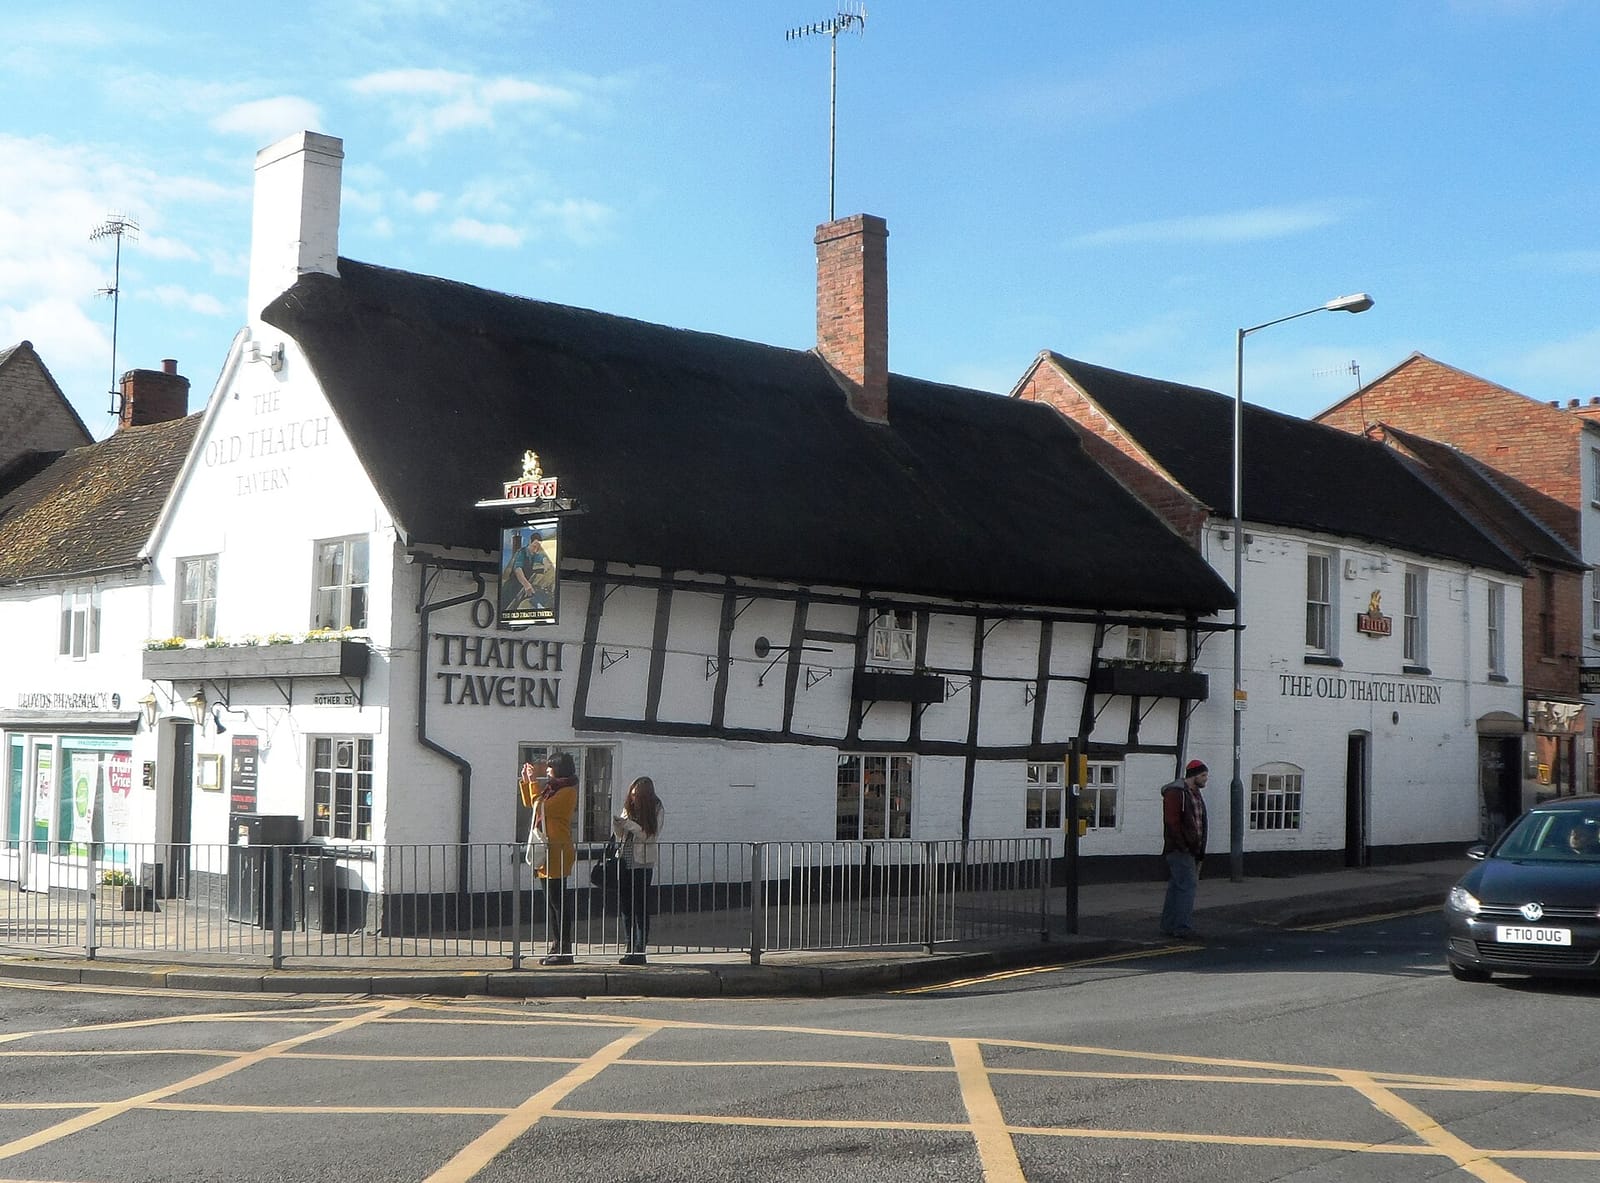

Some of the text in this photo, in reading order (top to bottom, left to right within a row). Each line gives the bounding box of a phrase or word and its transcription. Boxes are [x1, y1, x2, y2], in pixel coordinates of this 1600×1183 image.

[252, 390, 280, 415] THE
[205, 416, 330, 467] OLD THATCH
[236, 466, 291, 496] TAVERN
[435, 633, 564, 671] THATCH
[437, 672, 561, 708] TAVERN
[1280, 674, 1442, 704] THE OLD THATCH TAVERN
[112, 773, 131, 787] Price
[1506, 928, 1561, 942] FT10 OUG
